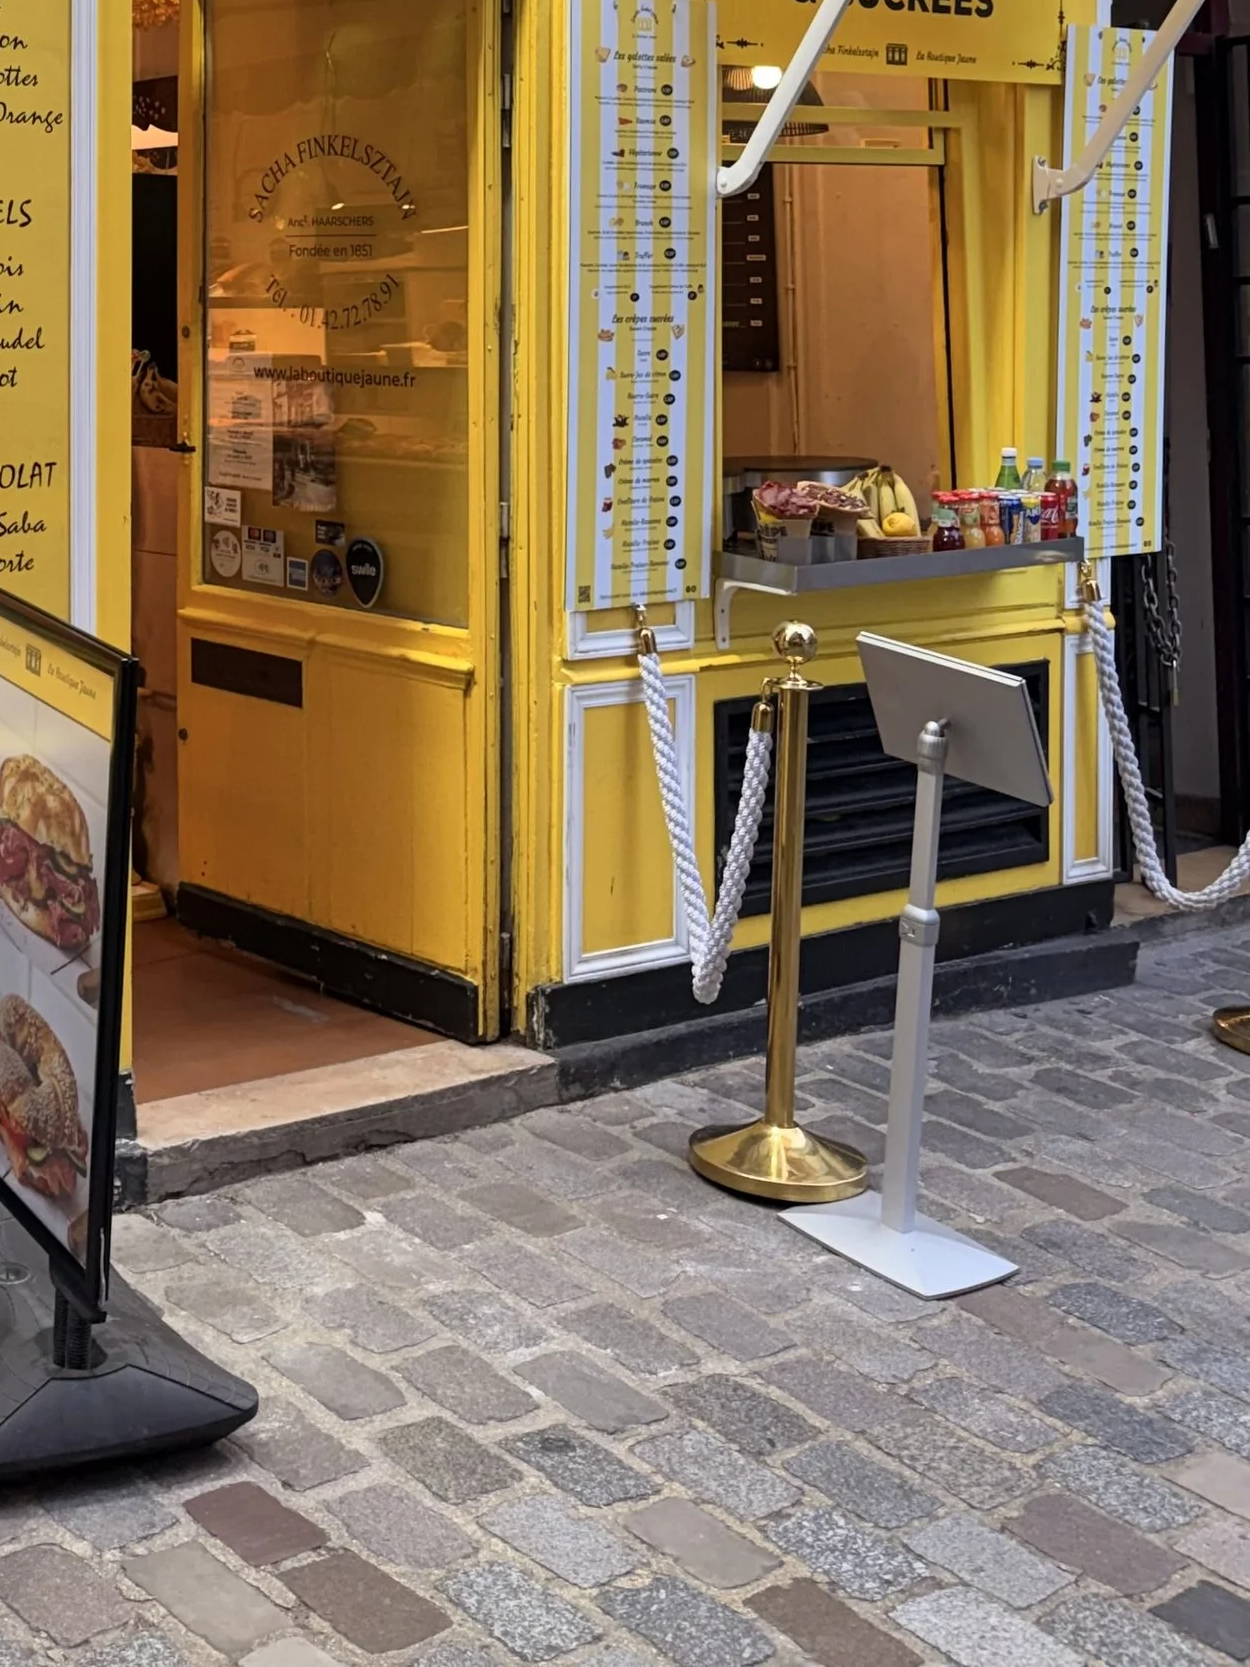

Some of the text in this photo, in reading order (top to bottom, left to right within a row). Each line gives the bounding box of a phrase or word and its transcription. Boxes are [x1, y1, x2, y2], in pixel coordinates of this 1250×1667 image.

[249, 134, 418, 224] SACHA FINKELSZTAJN
[288, 244, 332, 259] Fondée
[333, 246, 348, 258] en
[253, 365, 417, 389] www.laboutiquejaune.fr
